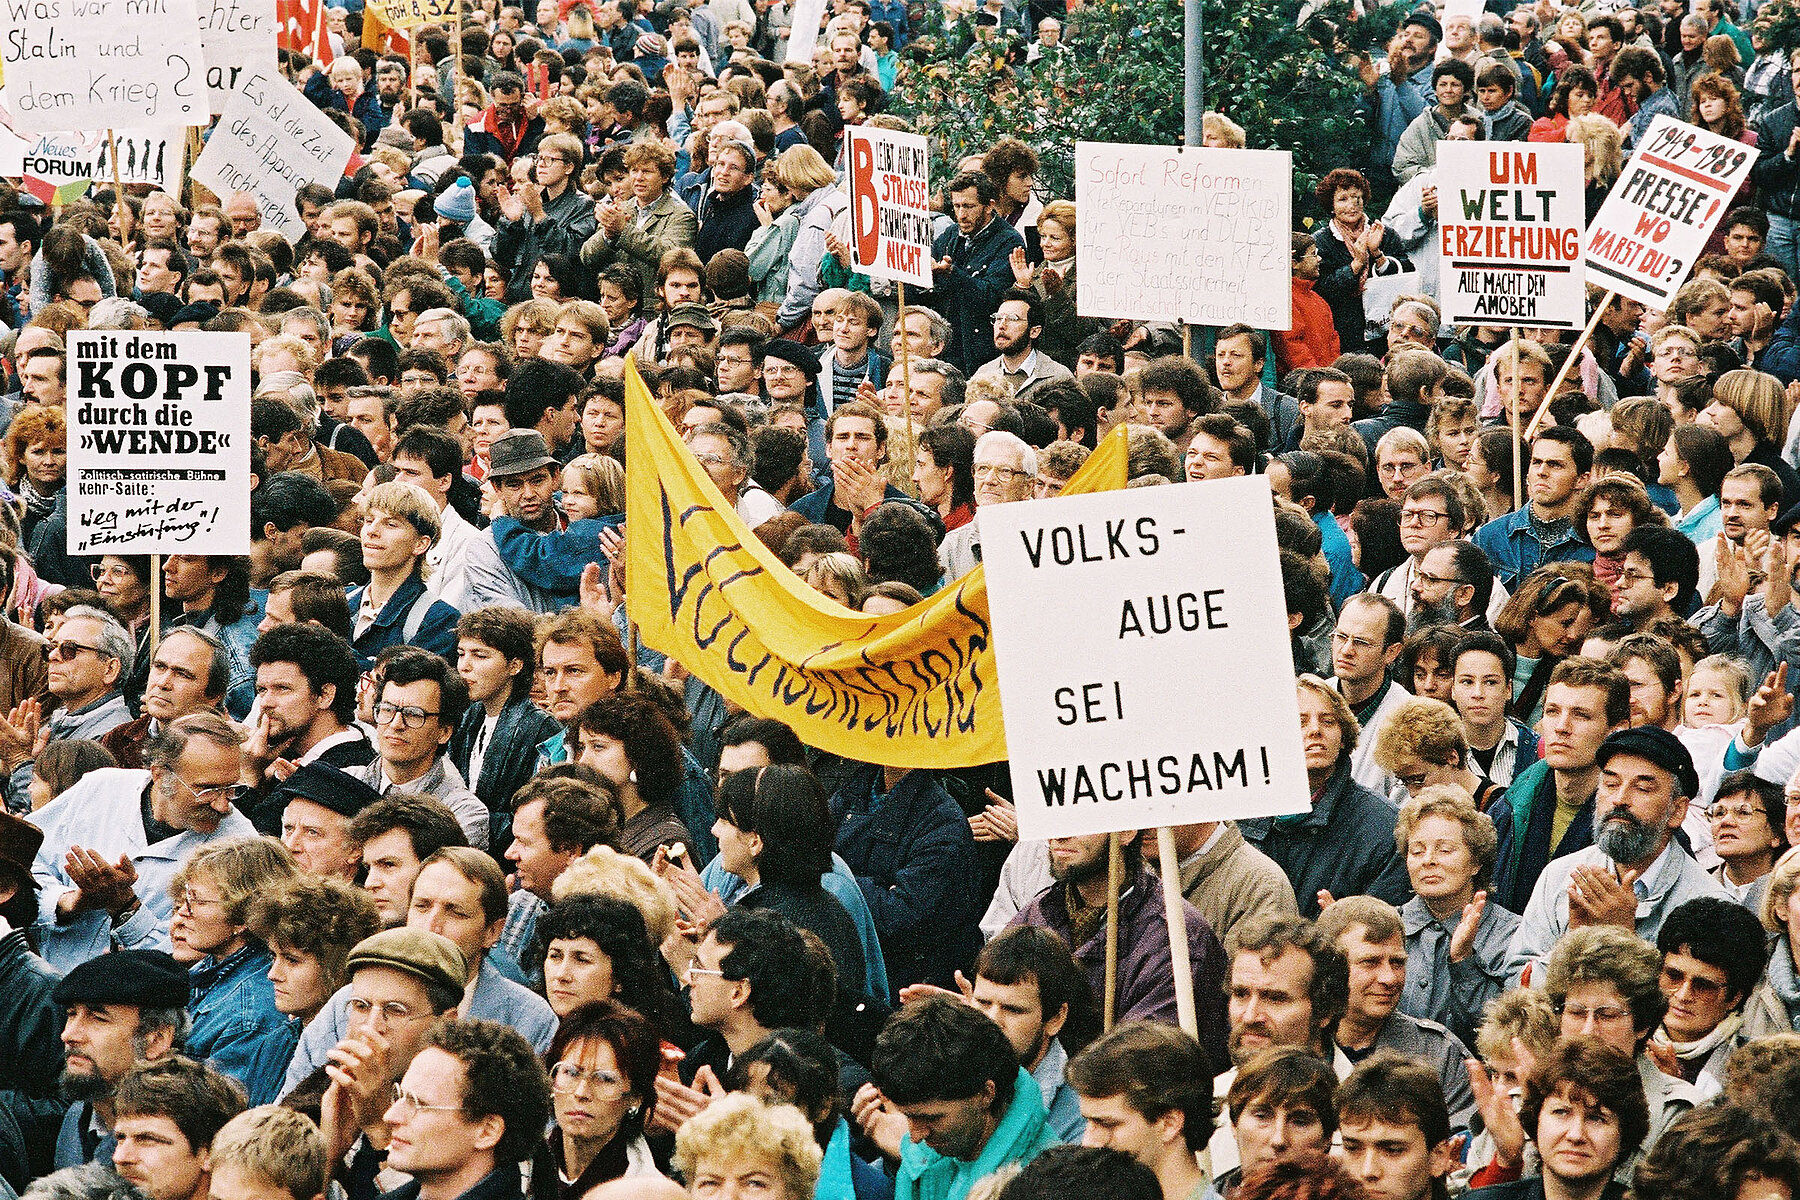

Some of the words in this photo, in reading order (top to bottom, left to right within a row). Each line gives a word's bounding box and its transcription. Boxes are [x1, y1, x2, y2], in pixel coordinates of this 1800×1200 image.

[6, 0, 60, 22] Was
[72, 0, 113, 17] war
[5, 27, 76, 62] Stalin
[98, 35, 144, 58] und
[18, 80, 76, 111] dem
[230, 116, 258, 148] des
[241, 74, 268, 107] Es
[266, 102, 290, 123] ist
[283, 117, 305, 140] die
[301, 129, 335, 163] Zeit
[28, 136, 78, 159] Neues
[22, 157, 92, 178] FORUM
[217, 161, 261, 193] nicht
[1089, 155, 1147, 189] Sofort
[1163, 158, 1263, 193] Reformen
[1489, 151, 1538, 185] UM
[881, 173, 928, 212] STRASSE
[1460, 188, 1557, 222] WELT
[1619, 167, 1721, 230] PRESSE!
[1181, 217, 1210, 241] und
[1441, 225, 1579, 261] ERZIEHUNG
[1633, 211, 1671, 244] WO
[886, 239, 922, 277] NICHT
[1194, 241, 1225, 268] den
[1587, 226, 1645, 269] WARST
[1636, 248, 1683, 283] DU?
[1095, 263, 1125, 287] der
[1129, 260, 1249, 296] Staatssicherheit
[1457, 271, 1481, 294] ALLE
[1483, 271, 1524, 297] MACHT
[1527, 273, 1546, 297] DEN
[1079, 282, 1107, 311] Die
[76, 335, 119, 359] mit
[125, 336, 178, 360] dem
[77, 361, 232, 401] KOPF
[77, 402, 148, 427] durch
[154, 403, 193, 427] die
[78, 469, 181, 481] Politisch-satirische
[186, 469, 221, 481] Bühne
[79, 481, 156, 496] Kehr-Saite:
[125, 498, 164, 519] mit
[165, 497, 204, 514] der
[1118, 589, 1229, 640] AUGE
[1053, 681, 1125, 726] SEI
[1036, 745, 1272, 807] WACHSAM!
